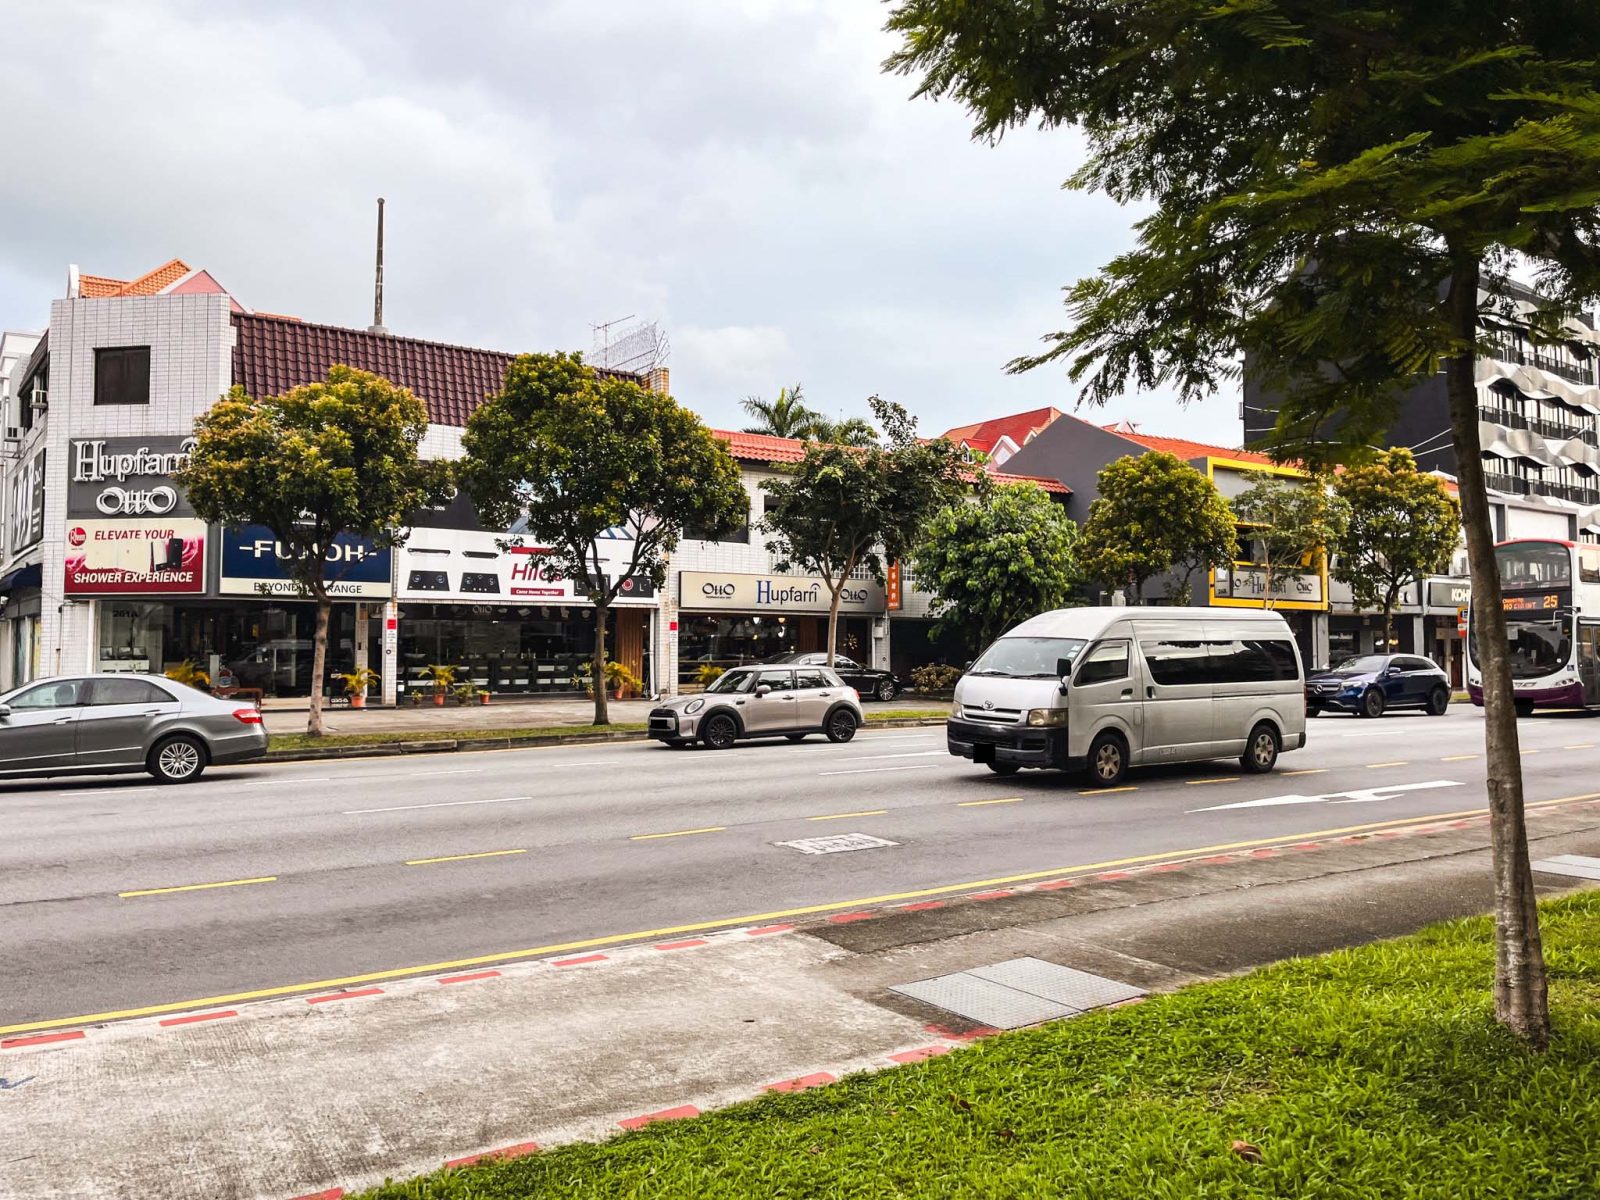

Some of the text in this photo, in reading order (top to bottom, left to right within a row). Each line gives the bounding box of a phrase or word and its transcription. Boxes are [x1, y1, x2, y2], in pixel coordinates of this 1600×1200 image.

[94, 529, 175, 541] ELEVATE YOUR
[74, 571, 194, 583] SHOWER EXPERIENCE
[756, 580, 820, 605] Hupfarri
[1451, 588, 1469, 602] KOH
[1543, 595, 1558, 608] 25
